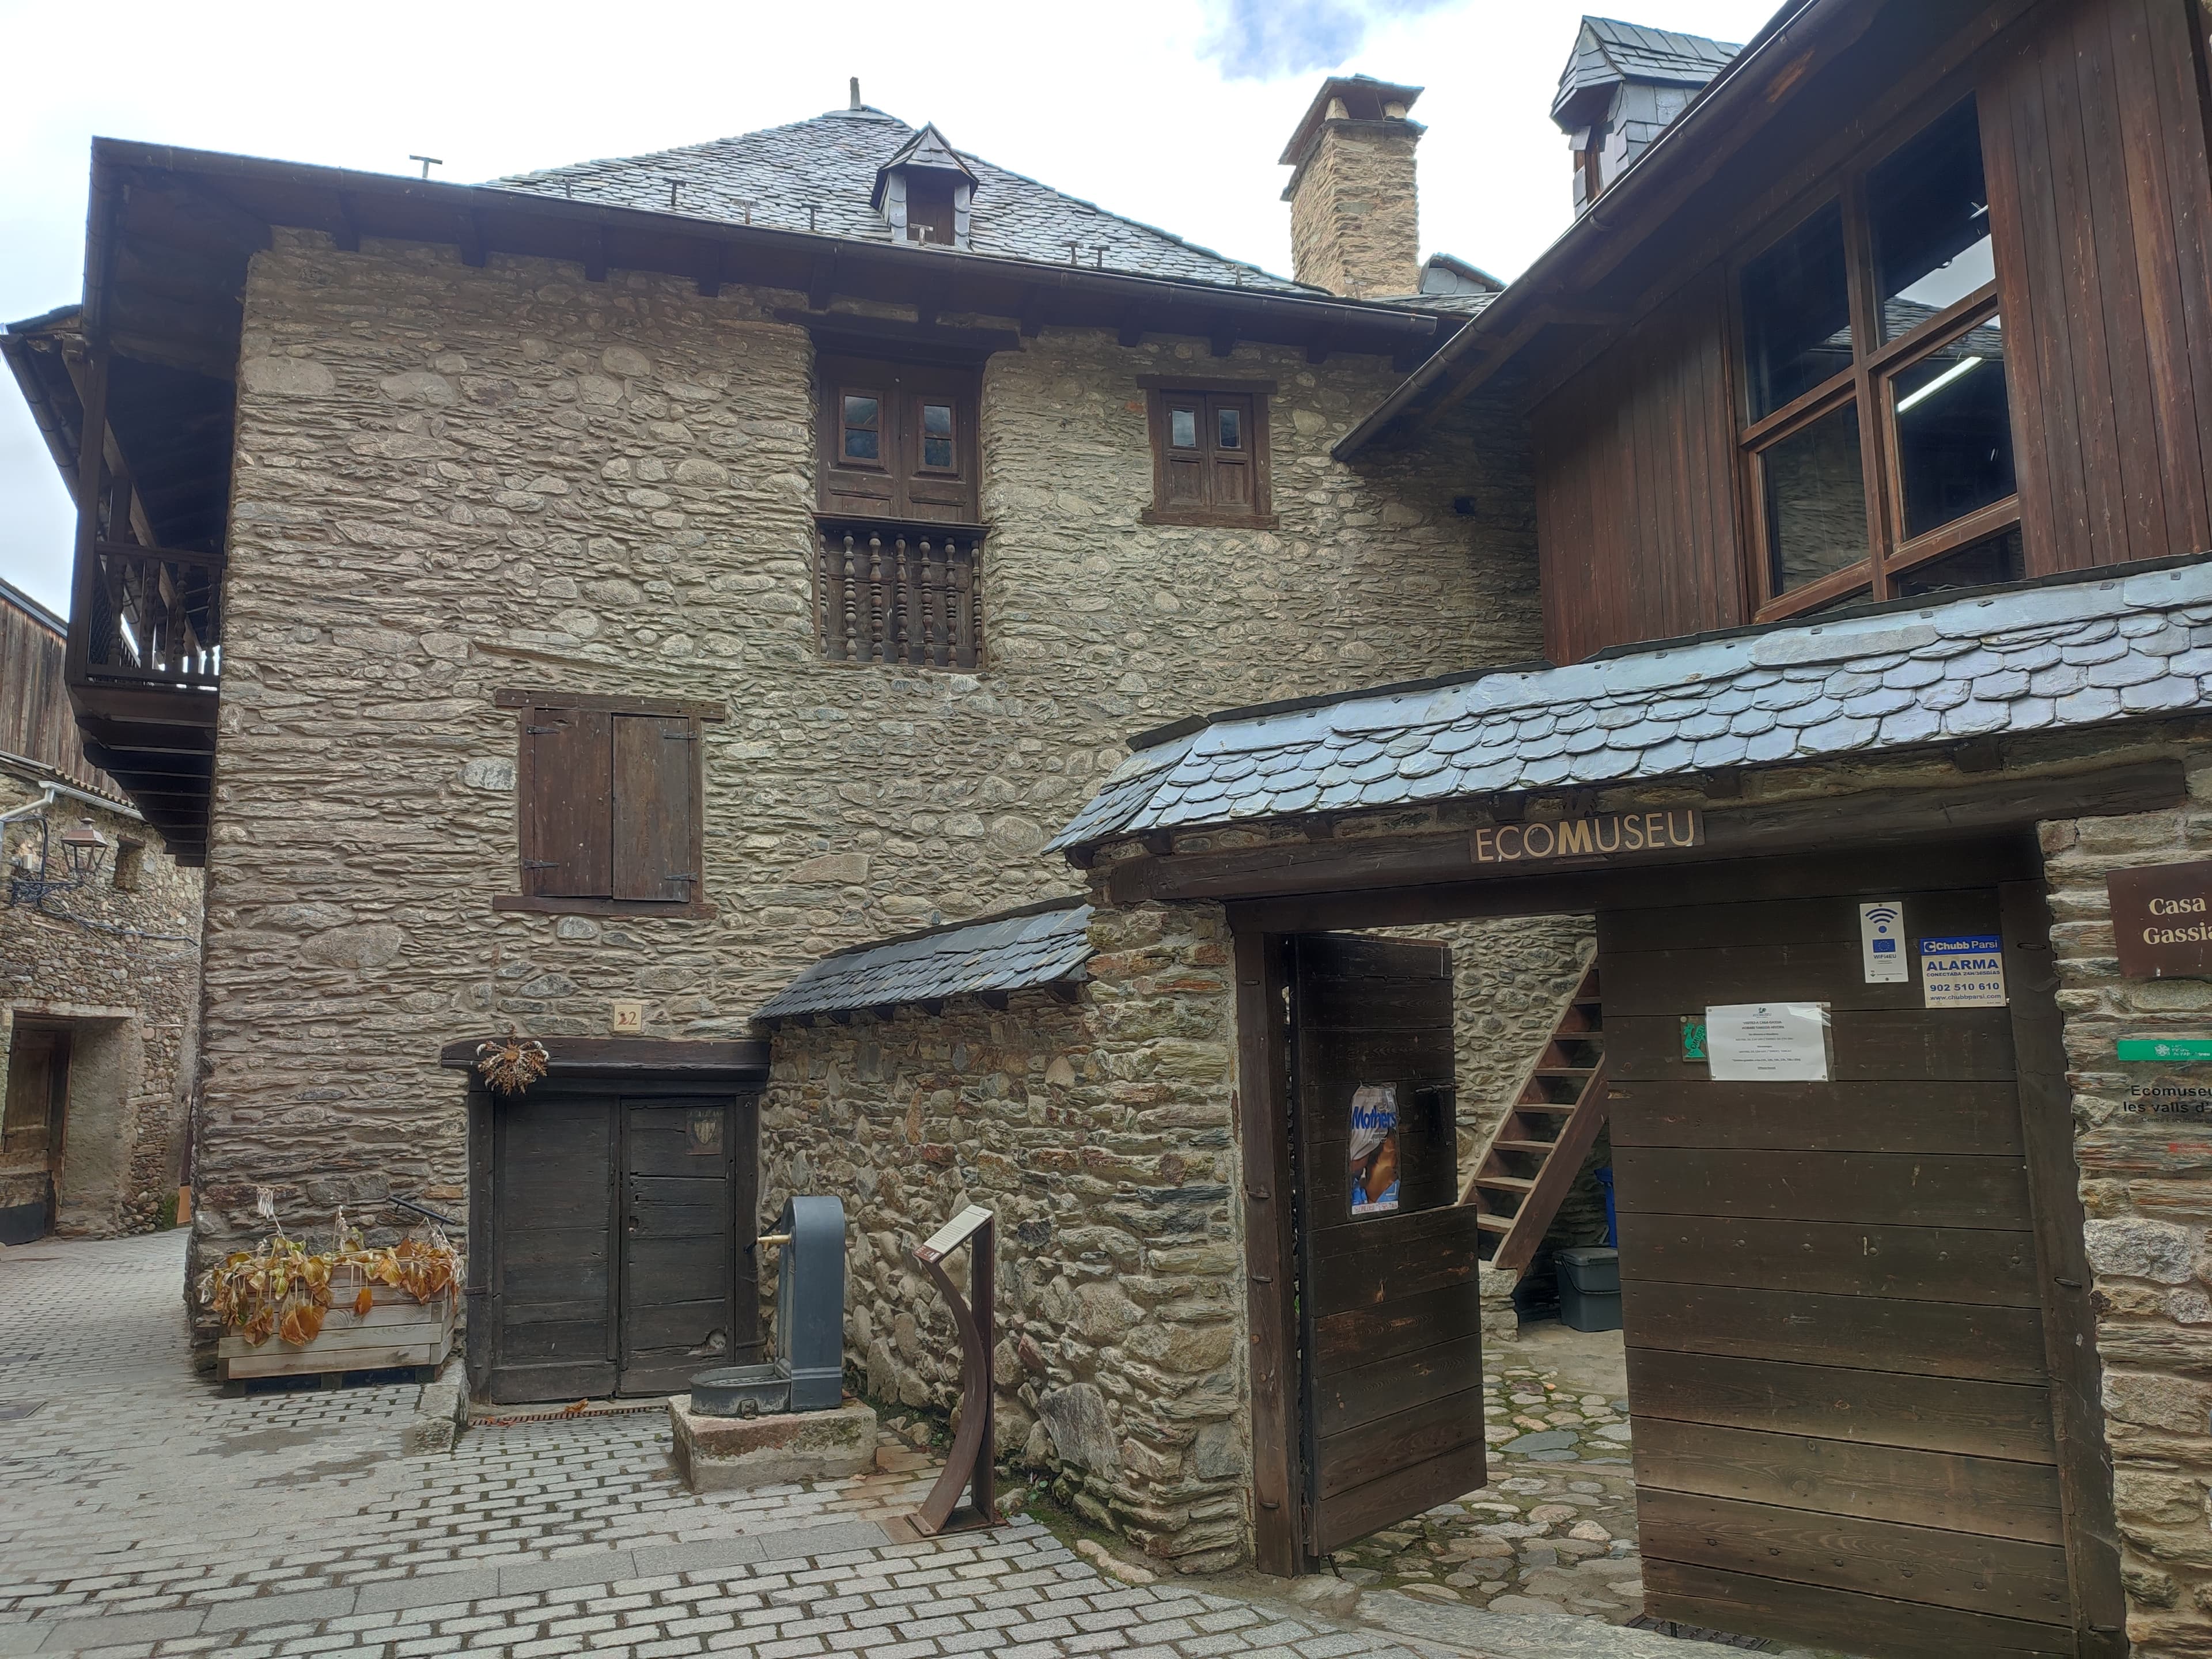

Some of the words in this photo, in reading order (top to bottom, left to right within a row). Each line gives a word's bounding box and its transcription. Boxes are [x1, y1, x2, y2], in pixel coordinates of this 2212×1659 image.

[1475, 809, 1695, 862] ECOMUSEU
[2149, 897, 2207, 915] Casa
[1936, 941, 1969, 950] Chubb
[1971, 940, 1998, 949] Parsi
[1926, 959, 1999, 971] ALARMA
[1930, 984, 1951, 992] 902
[1953, 983, 1975, 991] 510
[1978, 982, 2000, 990] 610
[2123, 1101, 2146, 1112] les
[2152, 1101, 2189, 1113] valls
[1351, 1104, 1397, 1130] Mothers
